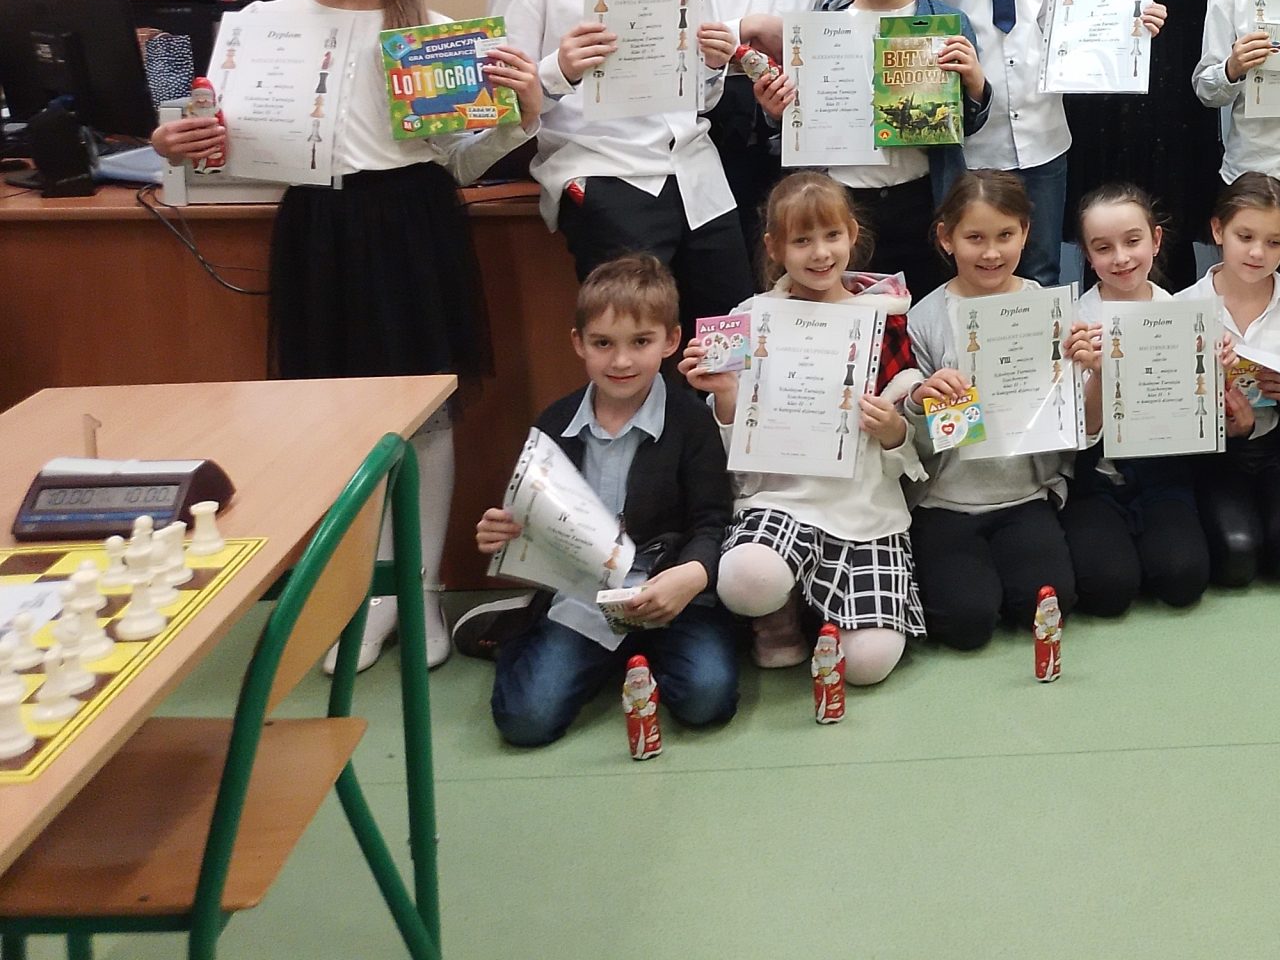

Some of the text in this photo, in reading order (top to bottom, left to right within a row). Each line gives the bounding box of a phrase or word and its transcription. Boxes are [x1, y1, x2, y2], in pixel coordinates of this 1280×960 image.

[267, 30, 303, 41] Dyplom
[823, 27, 852, 37] Dyplom
[883, 51, 939, 68] BITW
[1000, 306, 1030, 317] Dyplom
[700, 320, 742, 333] ALE PARY
[795, 317, 827, 328] Dyplom
[1142, 317, 1173, 327] Dyplom
